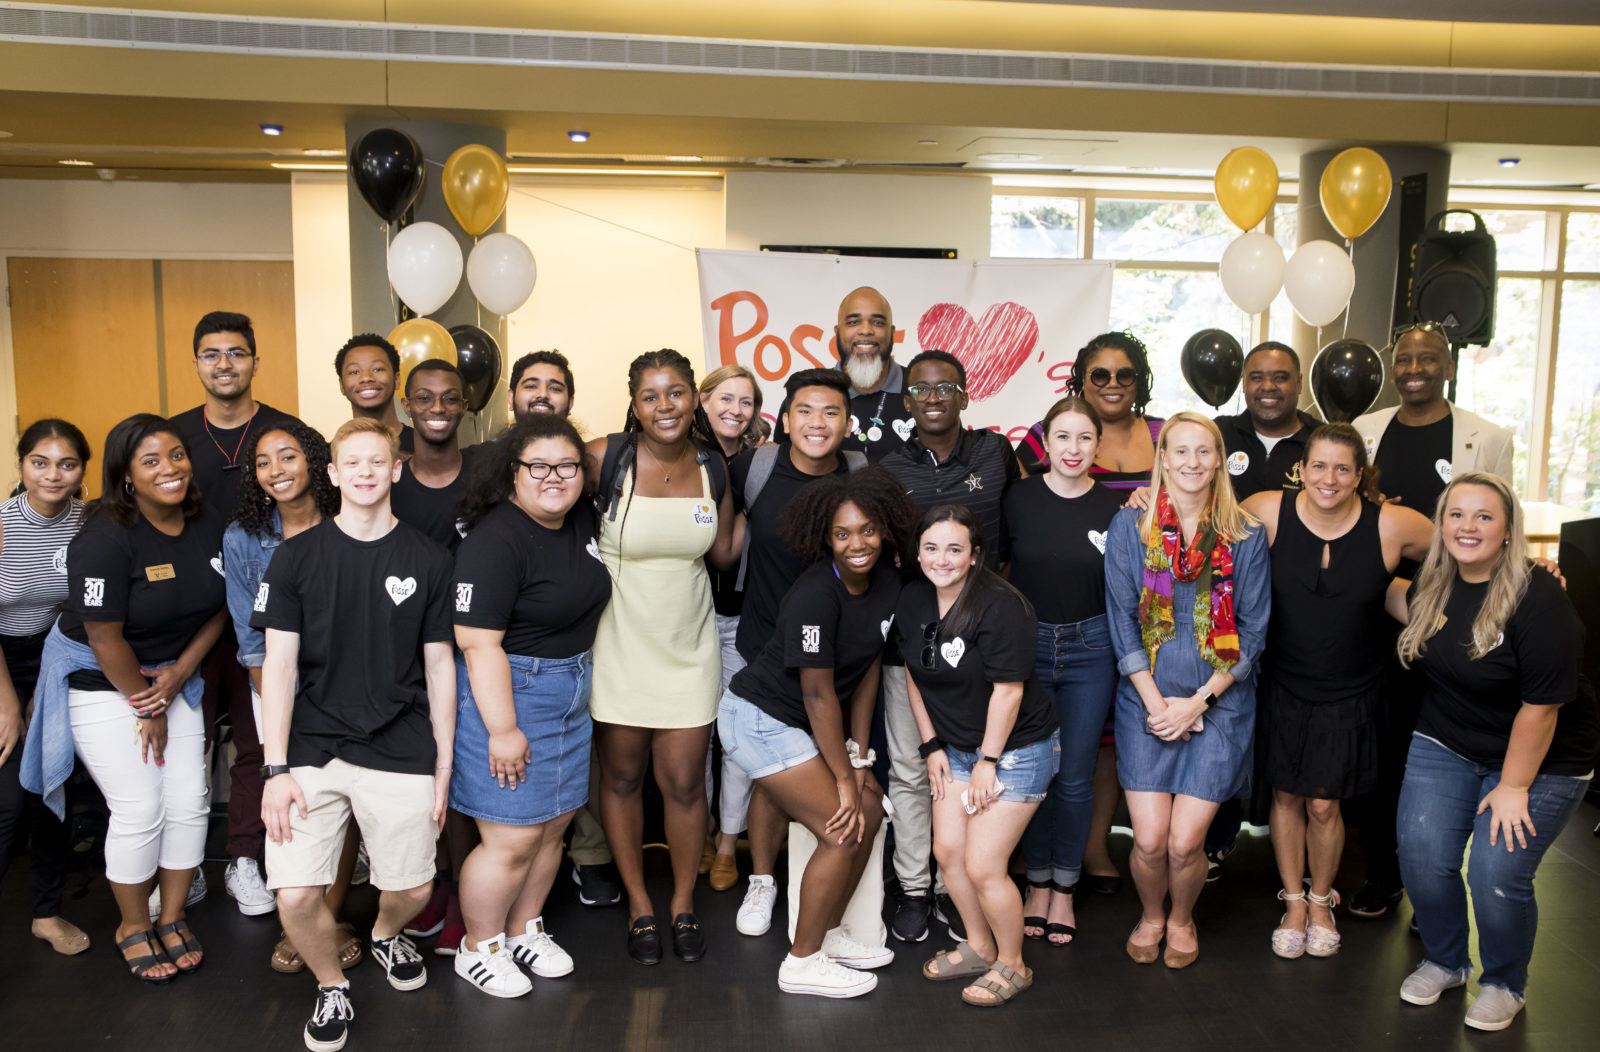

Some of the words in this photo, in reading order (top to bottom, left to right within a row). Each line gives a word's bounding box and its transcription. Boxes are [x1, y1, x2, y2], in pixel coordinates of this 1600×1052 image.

[84, 581, 105, 600] 30
[456, 587, 473, 605] 30
[802, 629, 820, 645] 30
[802, 644, 820, 653] YEARS
